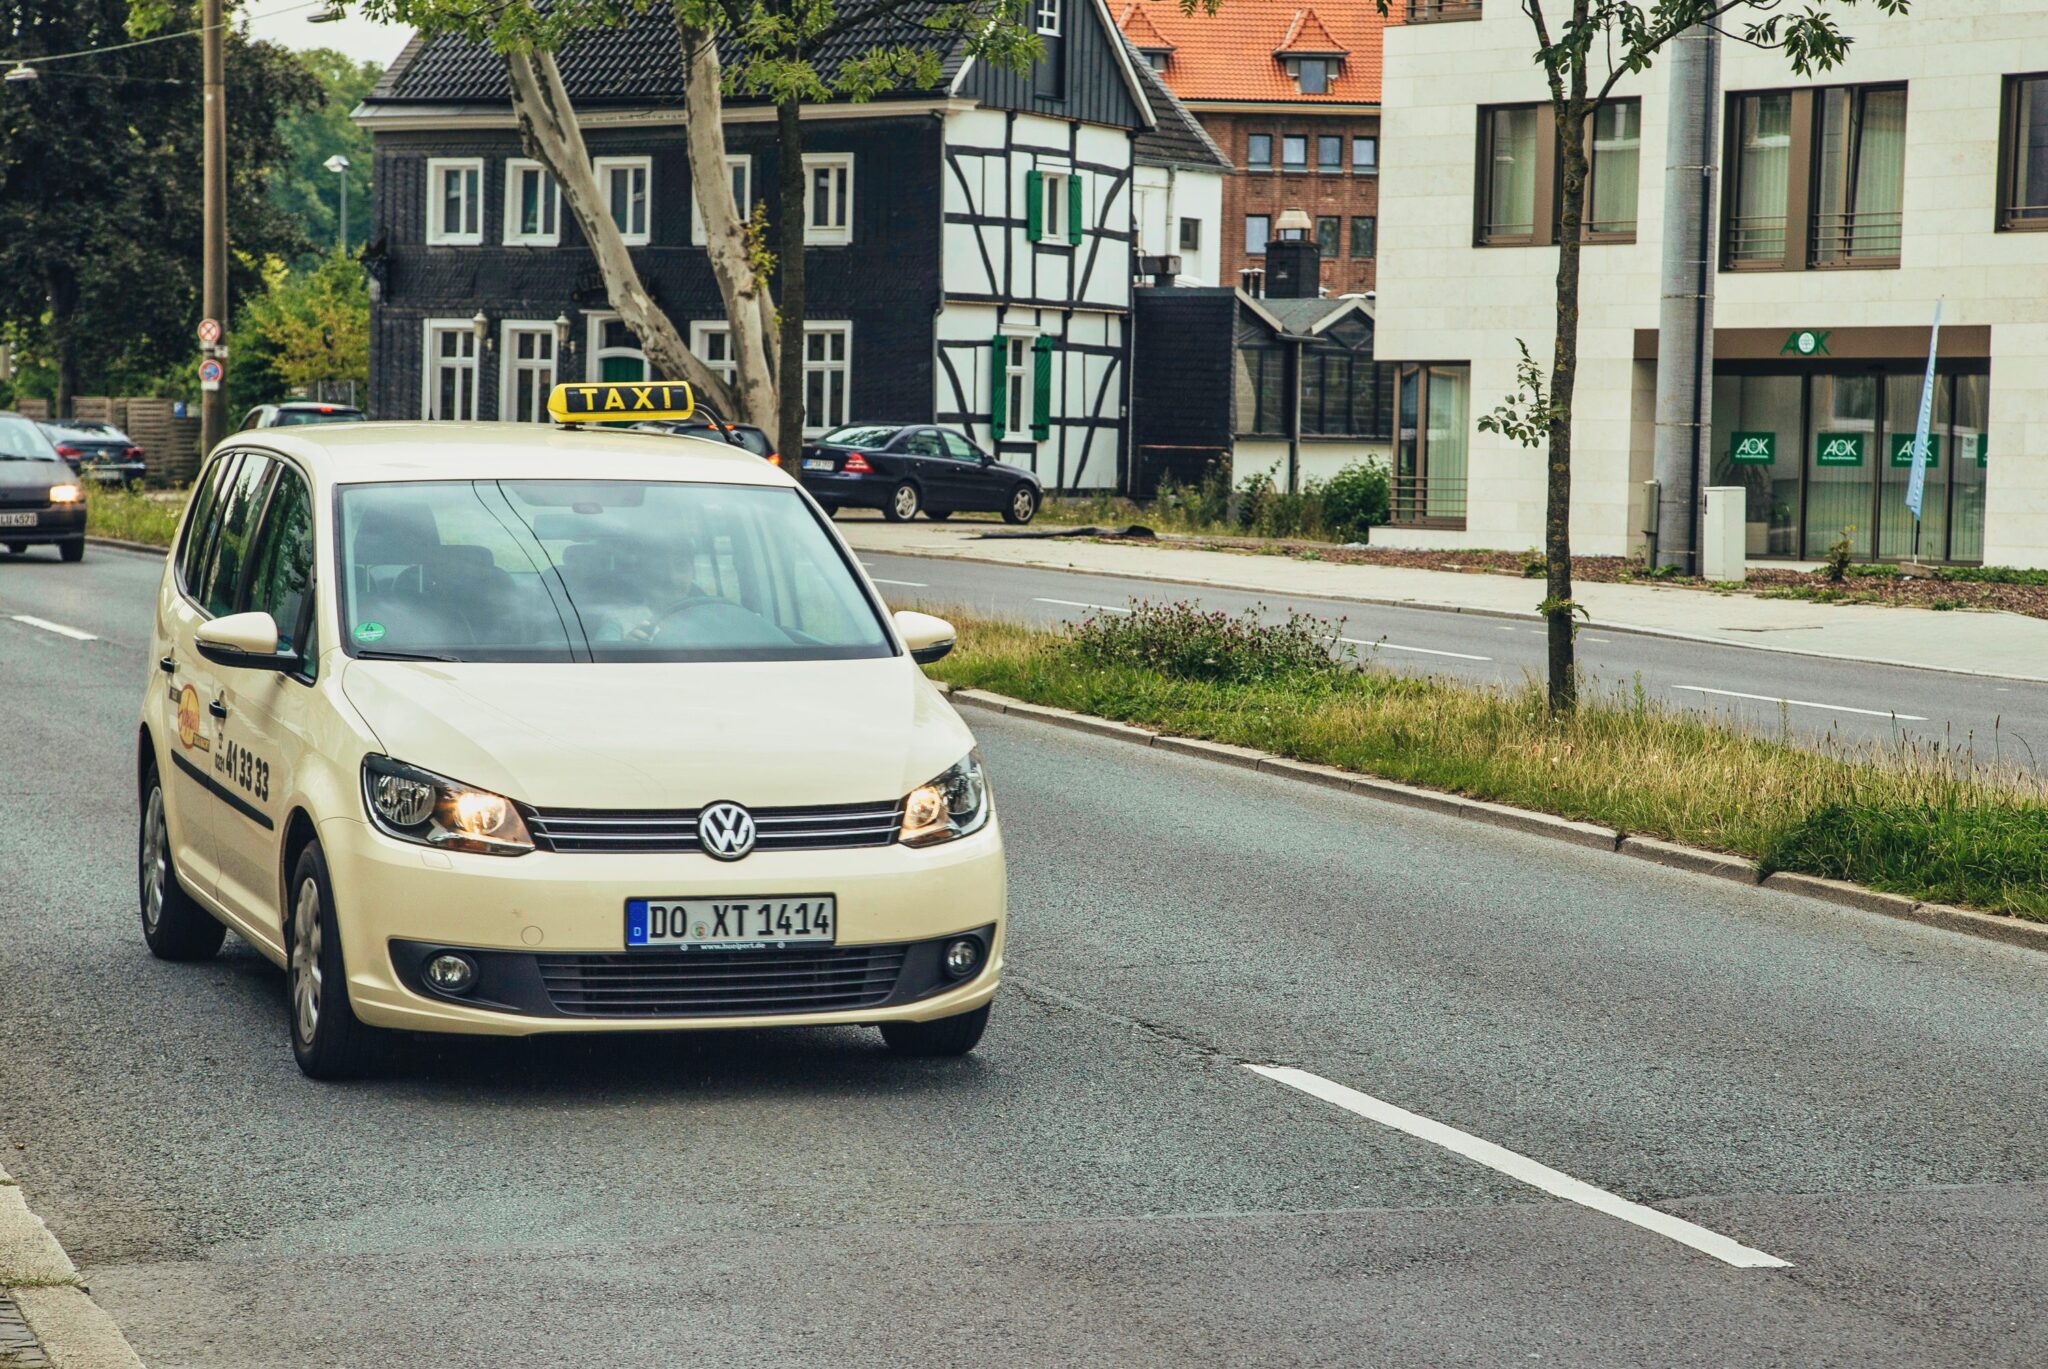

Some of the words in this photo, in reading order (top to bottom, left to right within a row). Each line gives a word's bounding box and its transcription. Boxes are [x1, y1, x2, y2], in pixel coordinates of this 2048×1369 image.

[1780, 330, 1831, 356] AOK
[579, 387, 672, 410] TAXI
[1736, 438, 1769, 454] AOK
[1823, 439, 1857, 456] AOK
[226, 740, 238, 782] 41
[239, 747, 253, 792] 33
[255, 757, 269, 802] 33
[699, 803, 756, 858] VW
[633, 927, 641, 937] D
[650, 905, 687, 938] DO
[712, 904, 749, 937] XT
[757, 903, 829, 936] 1414
